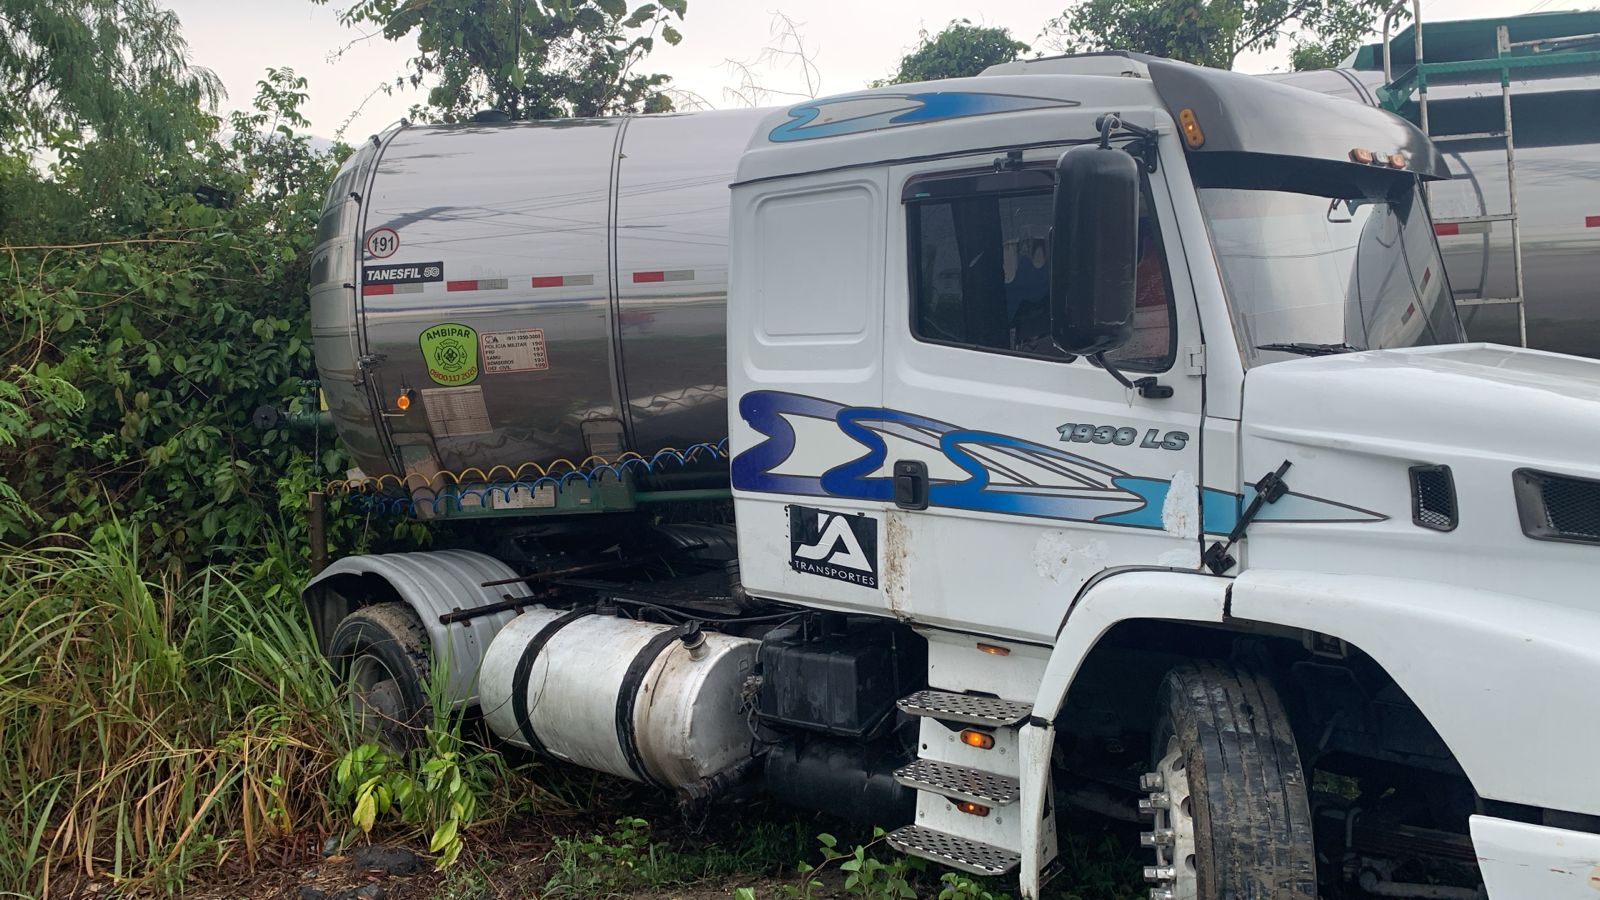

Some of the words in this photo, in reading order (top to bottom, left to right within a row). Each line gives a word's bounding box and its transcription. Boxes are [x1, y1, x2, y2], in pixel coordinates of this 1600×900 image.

[372, 236, 394, 252] 191
[366, 267, 422, 281] TANESFIL
[426, 328, 470, 341] AMBIPAR
[430, 368, 448, 381] 0800
[448, 374, 460, 382] 117
[461, 366, 477, 380] 2020
[1056, 422, 1138, 446] 1938
[1139, 428, 1190, 451] LS
[794, 512, 873, 573] JA
[794, 560, 875, 586] TRANSPORTES
